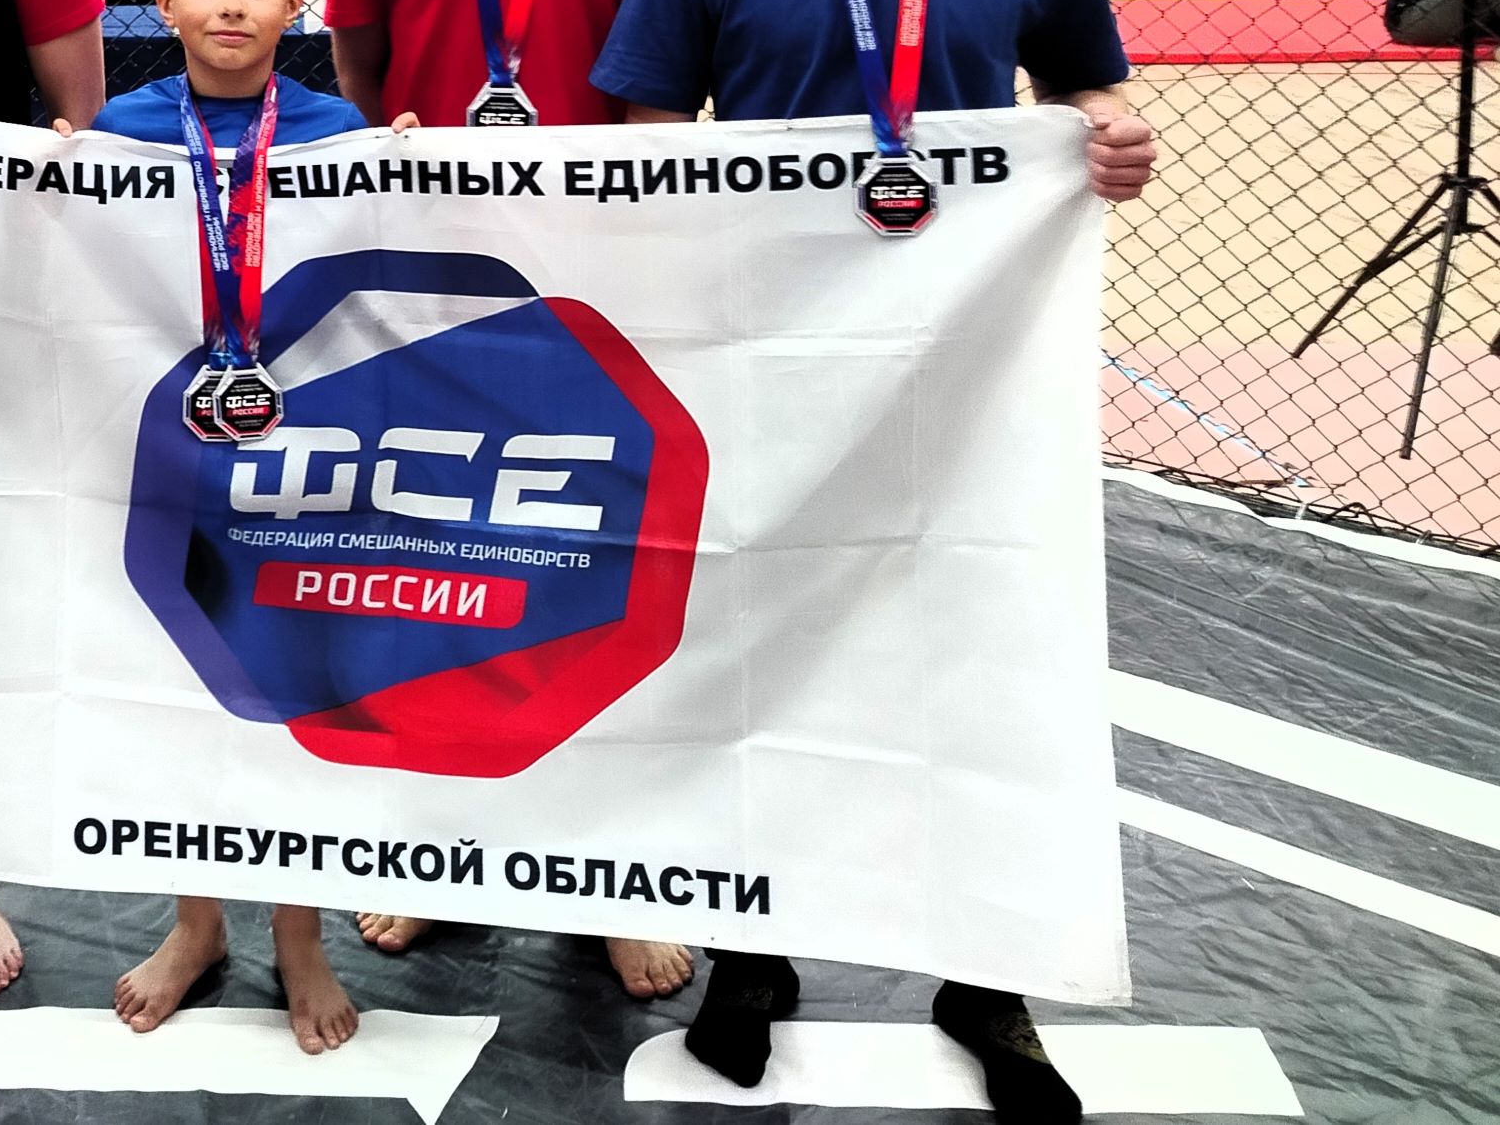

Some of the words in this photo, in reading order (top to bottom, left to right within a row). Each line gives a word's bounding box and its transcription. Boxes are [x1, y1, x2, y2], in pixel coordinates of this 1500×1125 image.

[195, 158, 545, 199] ЕШАННЫХ
[564, 145, 1010, 203] ЕДИНОБОТВ
[870, 185, 926, 200] ФСЕ
[225, 394, 271, 409] ФСЕ
[229, 426, 616, 531] ФСЕ
[227, 526, 334, 550] ФЕДЕРАЦИЯ
[337, 532, 457, 557] СМЕШАННЫХ
[460, 542, 591, 569] ЕДИНОБОРСТВ
[294, 569, 488, 619] РОССИИ
[72, 817, 486, 887] ОРЕНБУРГСКОЙ
[504, 852, 771, 915] ОБЛАСТИ
